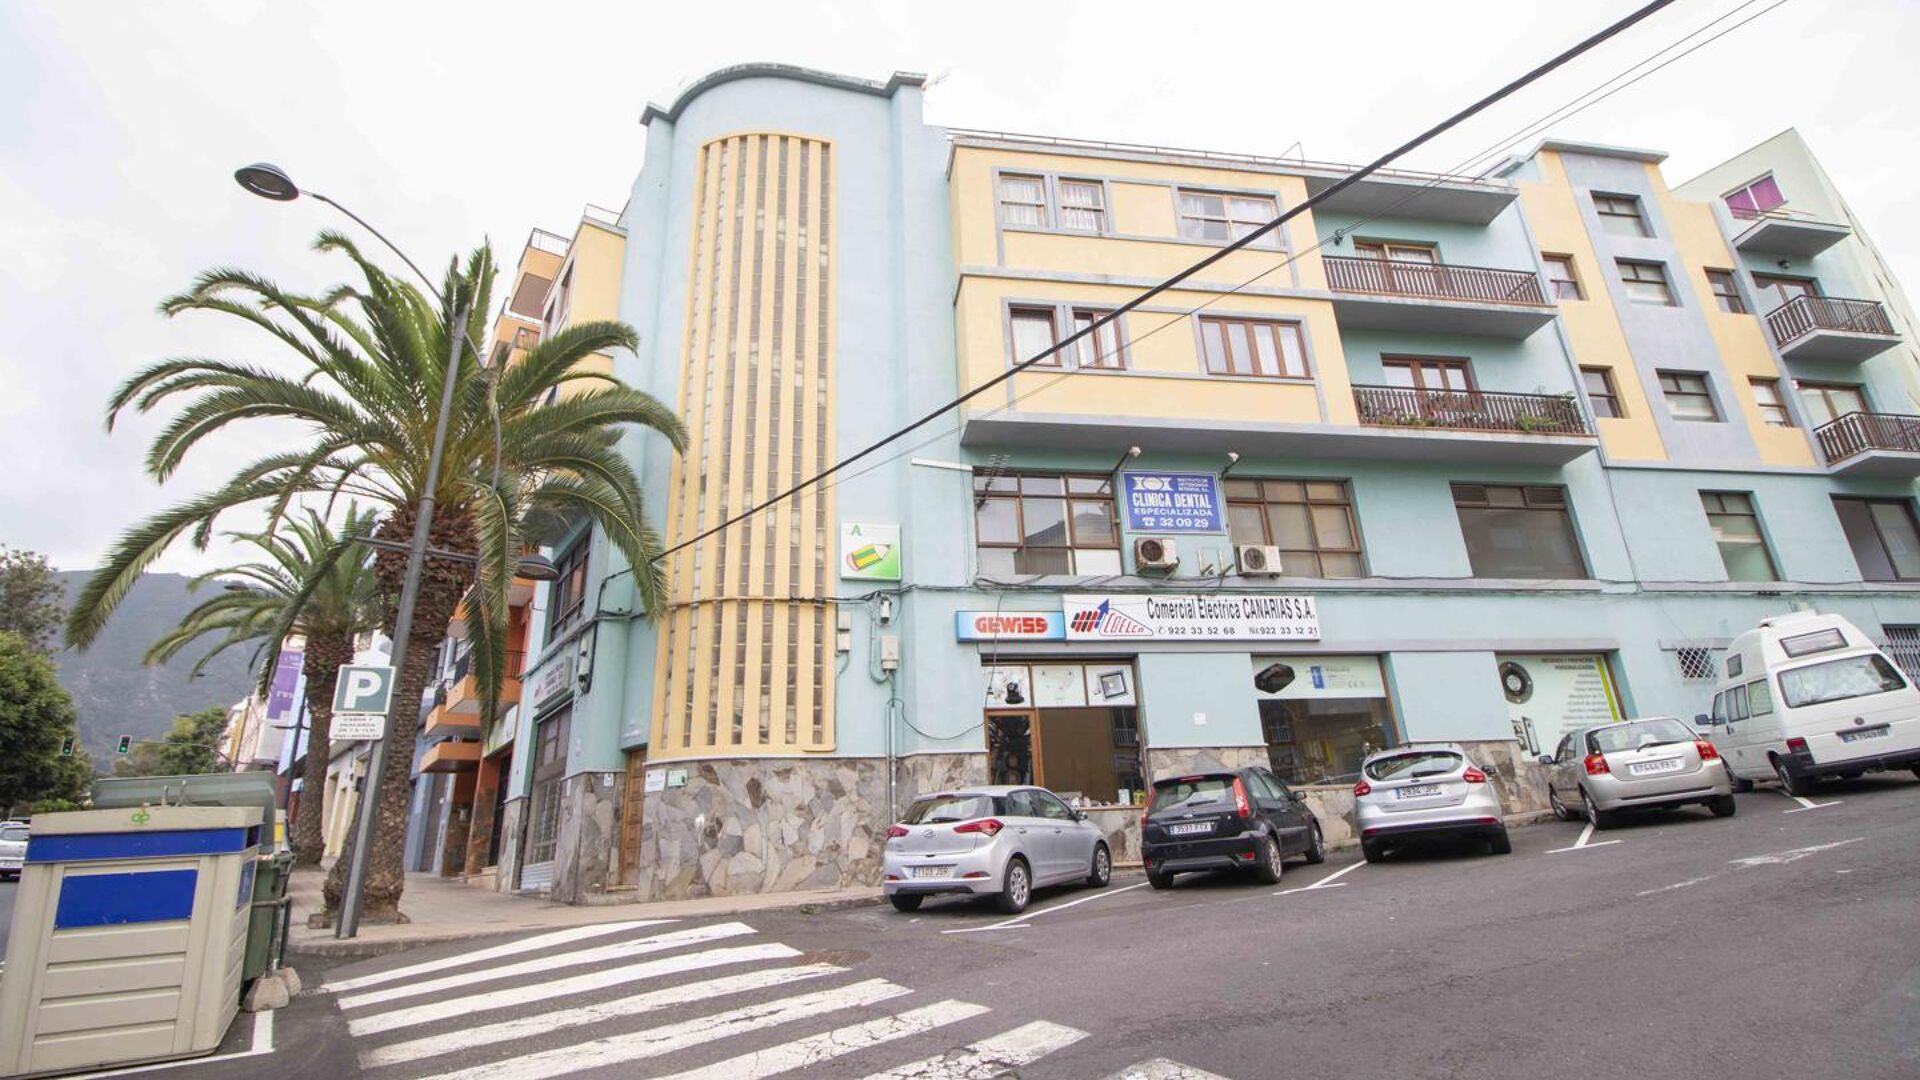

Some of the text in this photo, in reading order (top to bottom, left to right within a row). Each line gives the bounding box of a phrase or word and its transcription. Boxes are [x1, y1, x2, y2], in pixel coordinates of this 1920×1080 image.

[1132, 492, 1211, 508] CLINICA DENTAL
[1134, 508, 1213, 516] ESPECIALIZADA
[1160, 518, 1174, 526] 32
[1194, 519, 1209, 528] 29
[850, 525, 863, 536] A
[1147, 597, 1196, 619] Comercial
[1242, 597, 1293, 619] CANARIAS
[1294, 598, 1316, 619] S.A.
[1167, 626, 1186, 635] 922
[1190, 626, 1203, 635] 33
[1207, 626, 1219, 635] 52
[1223, 626, 1236, 635] 68
[1259, 626, 1276, 635] 922
[1280, 626, 1292, 635] 33
[1295, 626, 1305, 635] 12
[1308, 627, 1318, 635] 21
[343, 670, 382, 709] P
